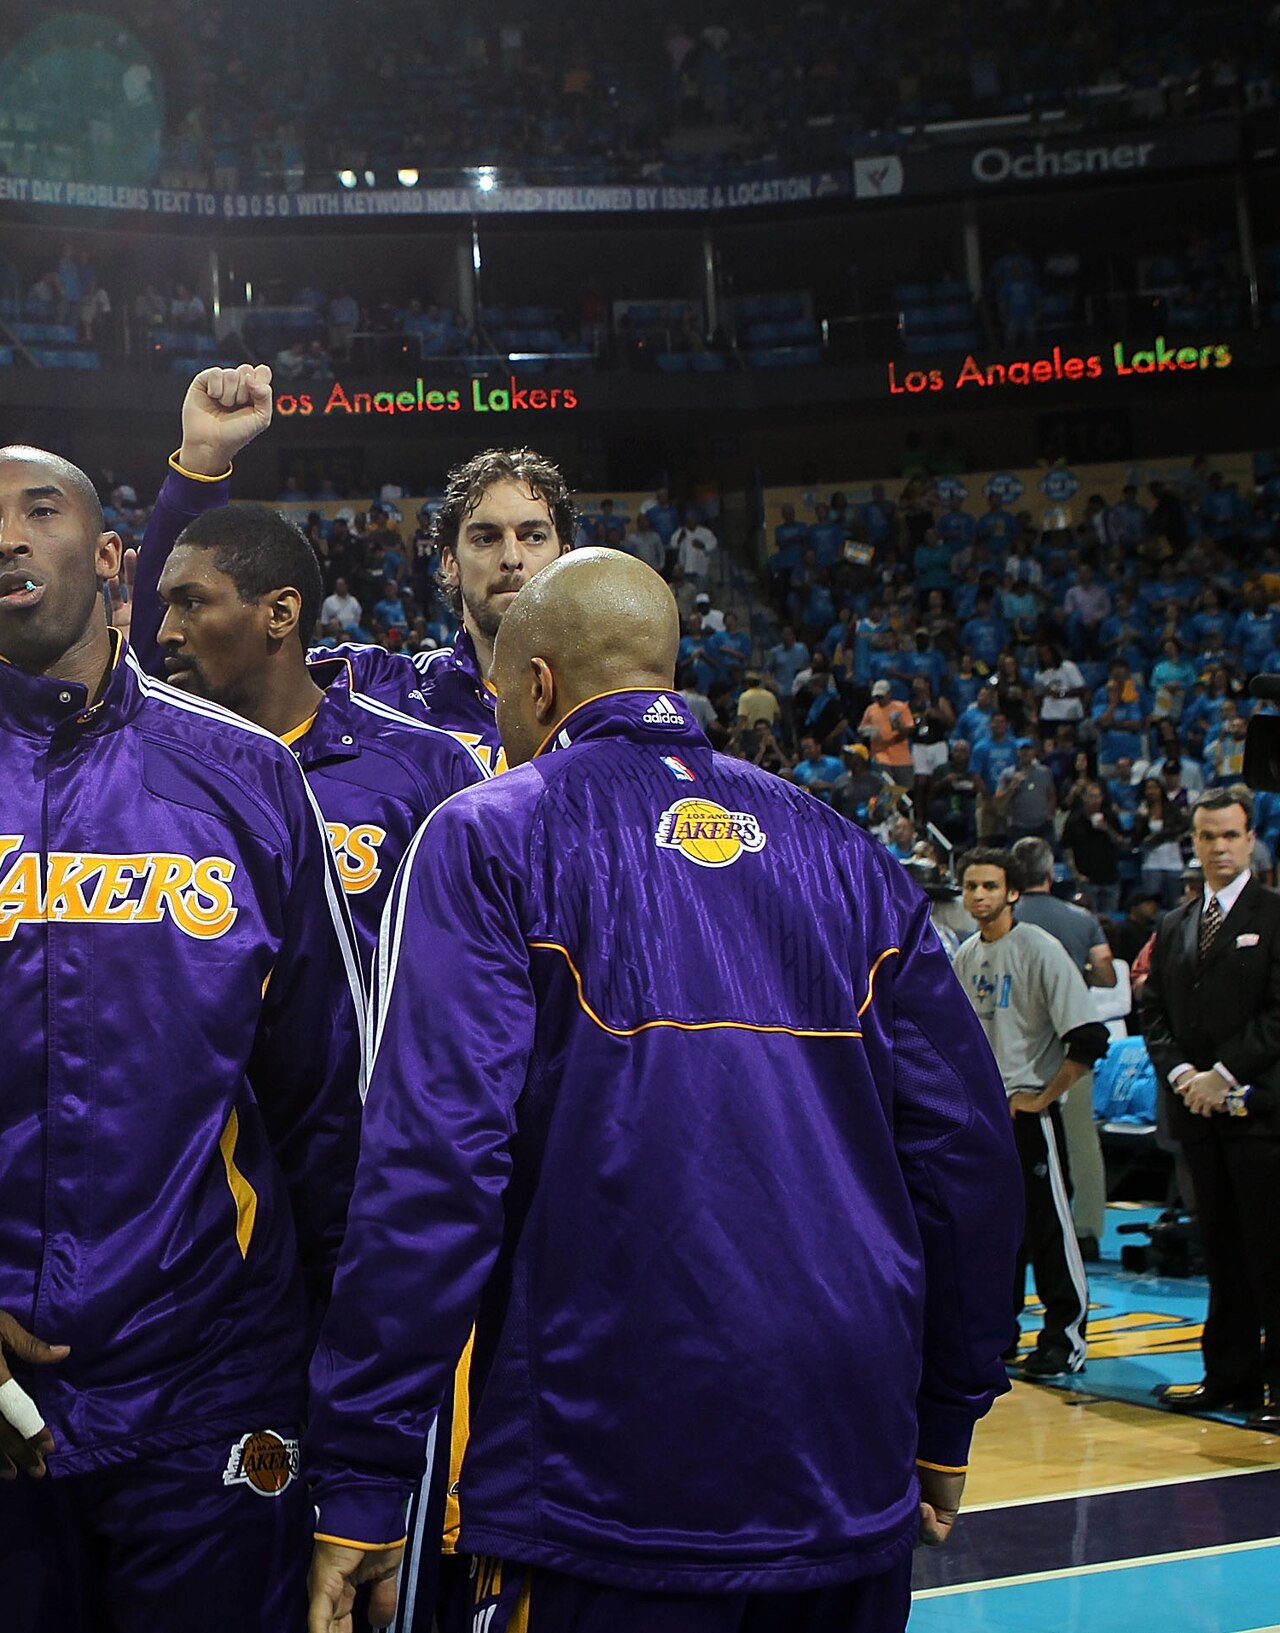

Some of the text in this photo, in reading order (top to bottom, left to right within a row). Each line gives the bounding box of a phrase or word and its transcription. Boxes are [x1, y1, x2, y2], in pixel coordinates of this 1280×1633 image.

[972, 142, 1154, 182] Ochsner
[32, 180, 62, 202] DAY
[66, 182, 149, 210] PROBLEMS
[152, 189, 194, 213] TEXT
[197, 193, 215, 215] TO
[297, 192, 338, 215] WITH
[547, 188, 632, 211] FOLLOWED
[636, 188, 658, 210] BY
[662, 187, 709, 210] ISSUE
[728, 177, 812, 206] LOCATION
[888, 335, 1232, 394] Los Angeles Lakers
[324, 378, 461, 415] Angeles
[472, 376, 577, 412] Lakers
[643, 713, 684, 725] adidas
[665, 813, 758, 848] LAKERS
